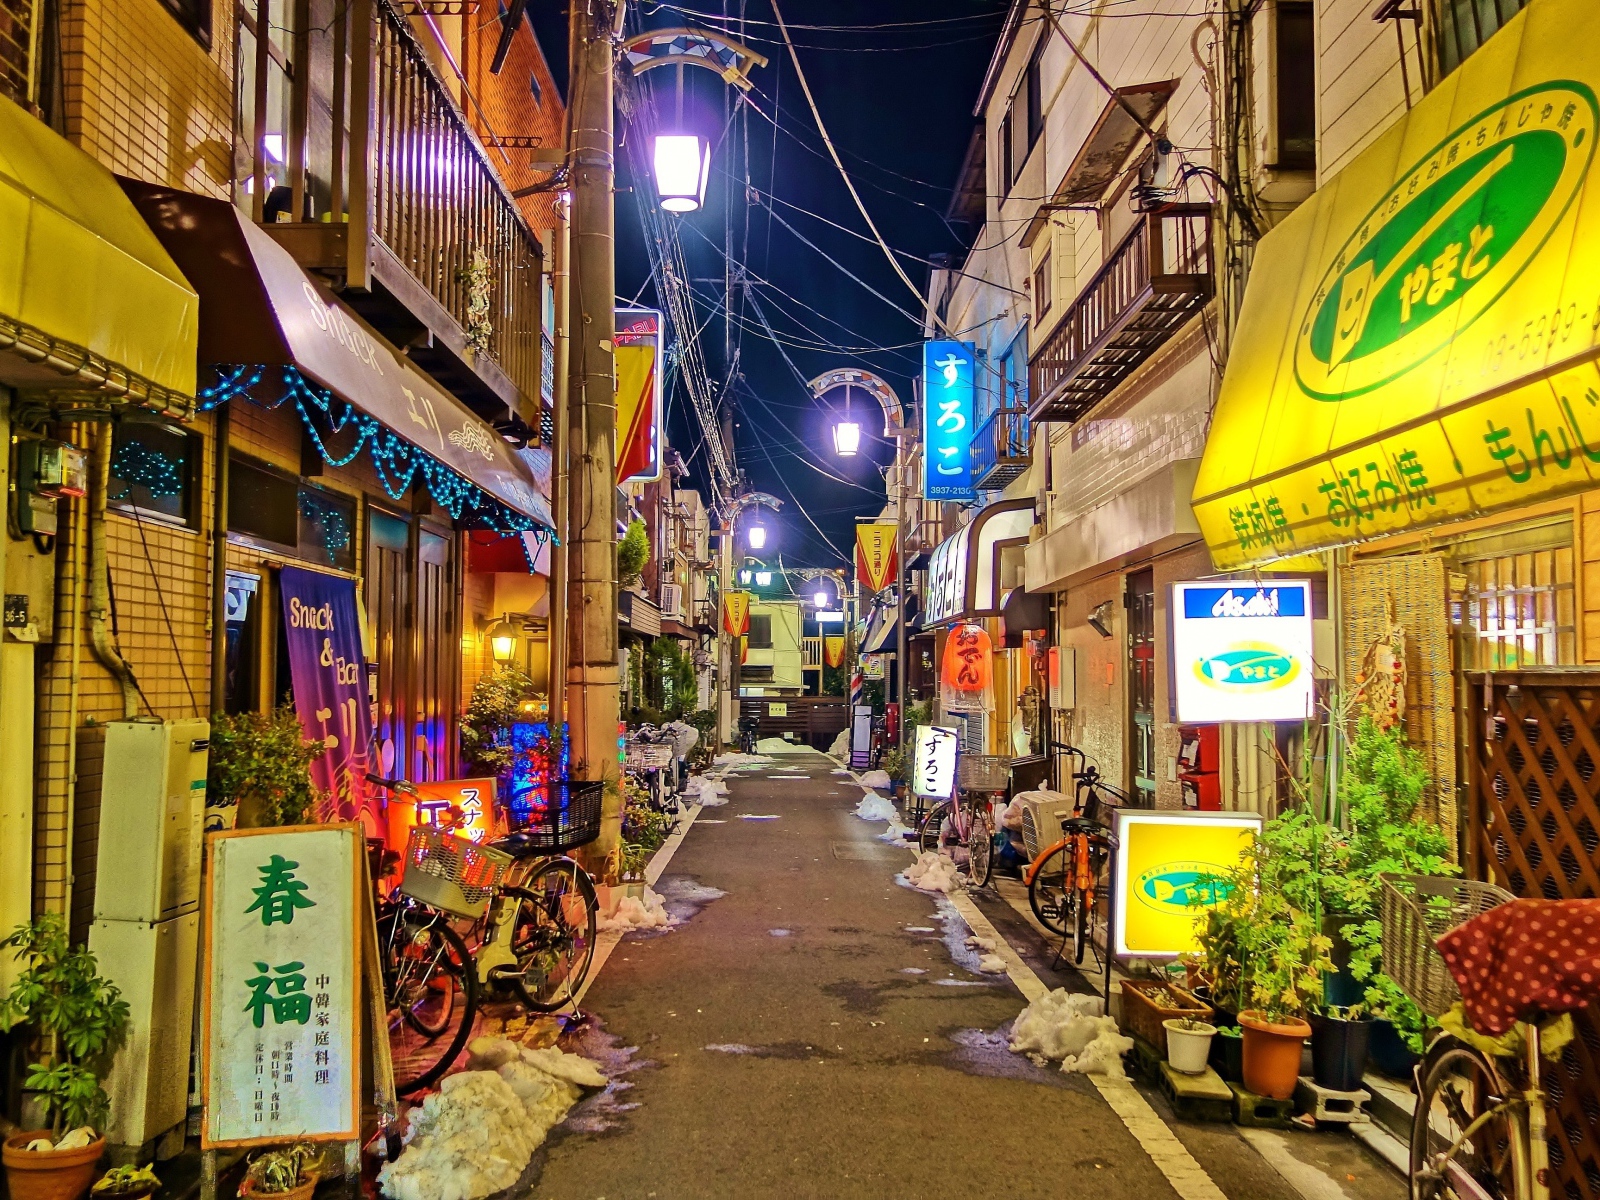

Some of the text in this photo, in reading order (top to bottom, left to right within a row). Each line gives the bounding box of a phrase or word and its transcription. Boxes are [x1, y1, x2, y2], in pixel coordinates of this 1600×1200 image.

[1400, 224, 1494, 324] やまと
[302, 281, 384, 376] Snack
[401, 385, 444, 450] エリ
[934, 353, 968, 475] すろこ
[873, 531, 882, 577] ニコニコ通り
[290, 597, 335, 631] Snack
[1211, 589, 1279, 617] Asahi
[320, 637, 334, 667] &
[336, 656, 359, 685] Bar
[956, 629, 983, 684] おでん
[315, 698, 357, 755] エリ
[925, 738, 942, 793] すろこ
[461, 788, 483, 844] スナッ
[243, 854, 318, 1029] 春福
[315, 973, 330, 1085] 中韓家庭料理
